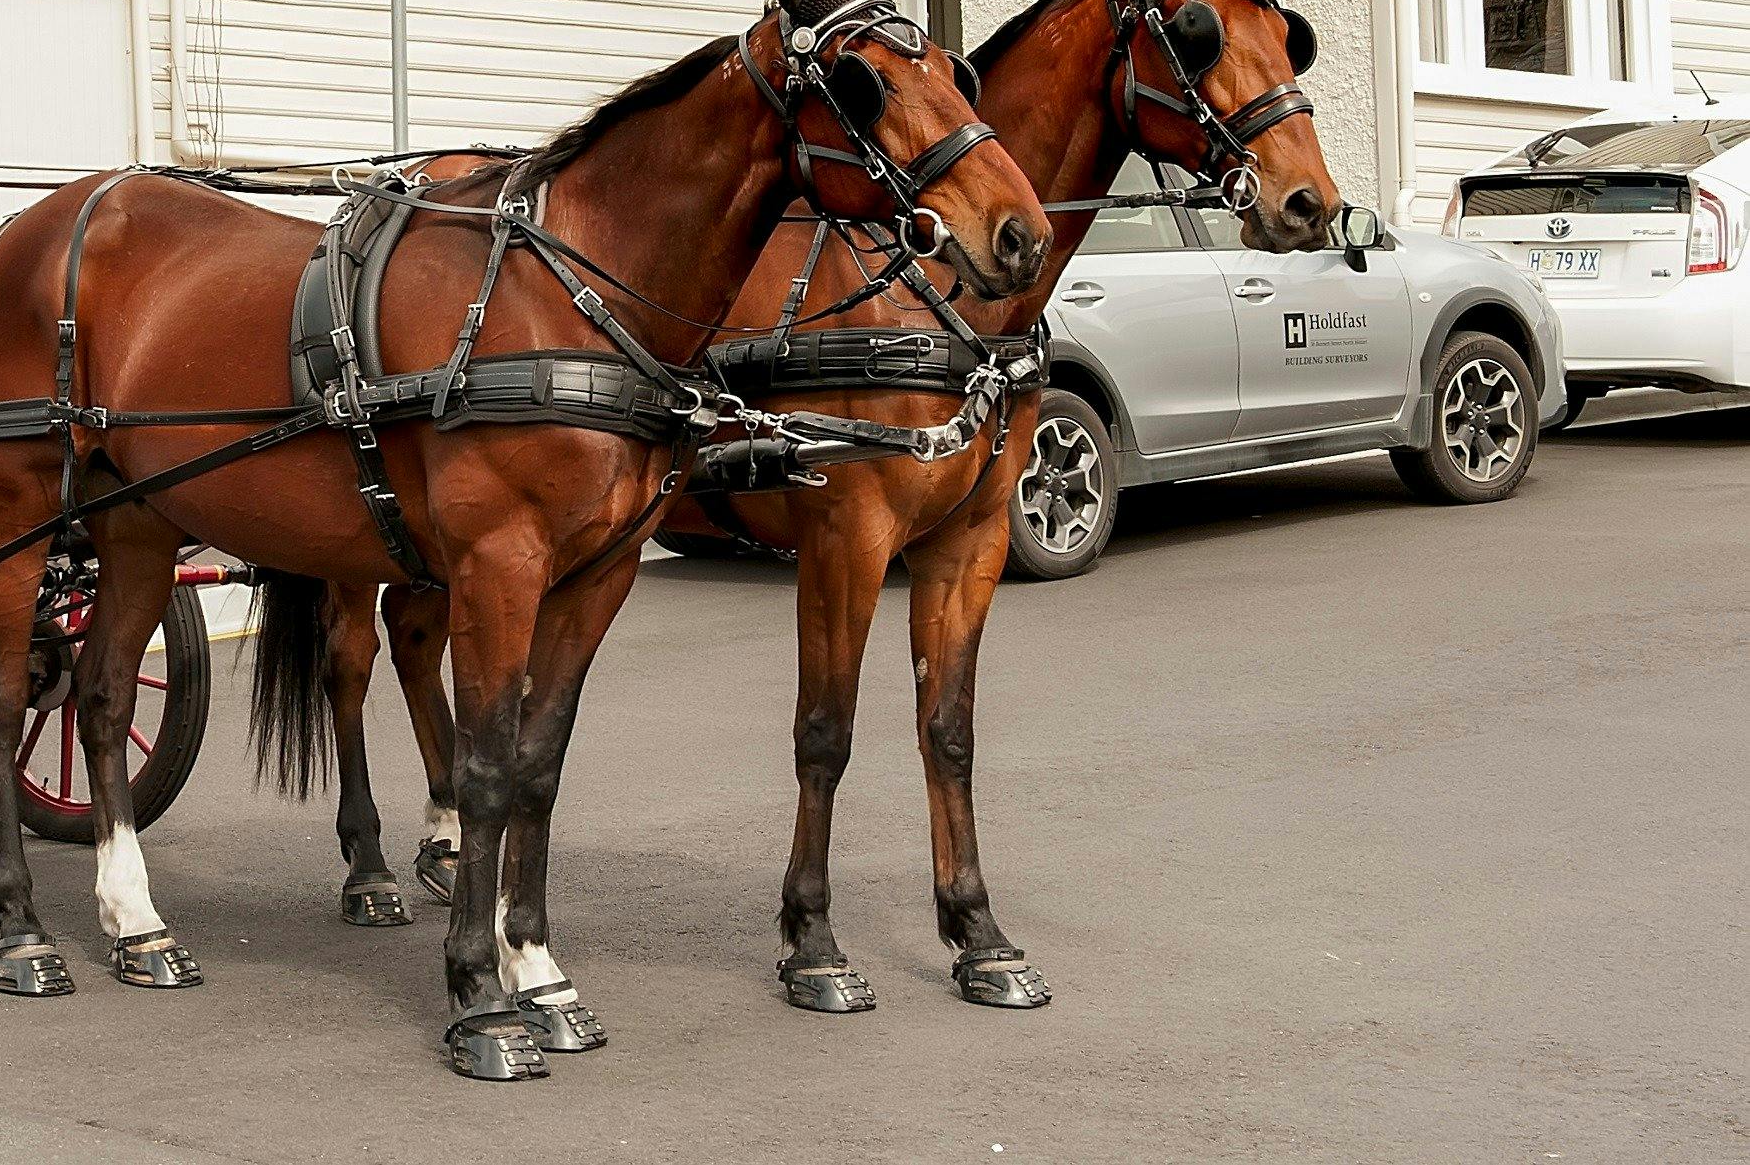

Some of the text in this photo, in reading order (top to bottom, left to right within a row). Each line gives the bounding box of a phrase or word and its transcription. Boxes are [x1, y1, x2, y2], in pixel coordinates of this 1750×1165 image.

[1531, 252, 1598, 271] H 79 XX
[1309, 312, 1368, 330] Holdfast
[1285, 353, 1368, 366] BUILDING SURVEYORS
